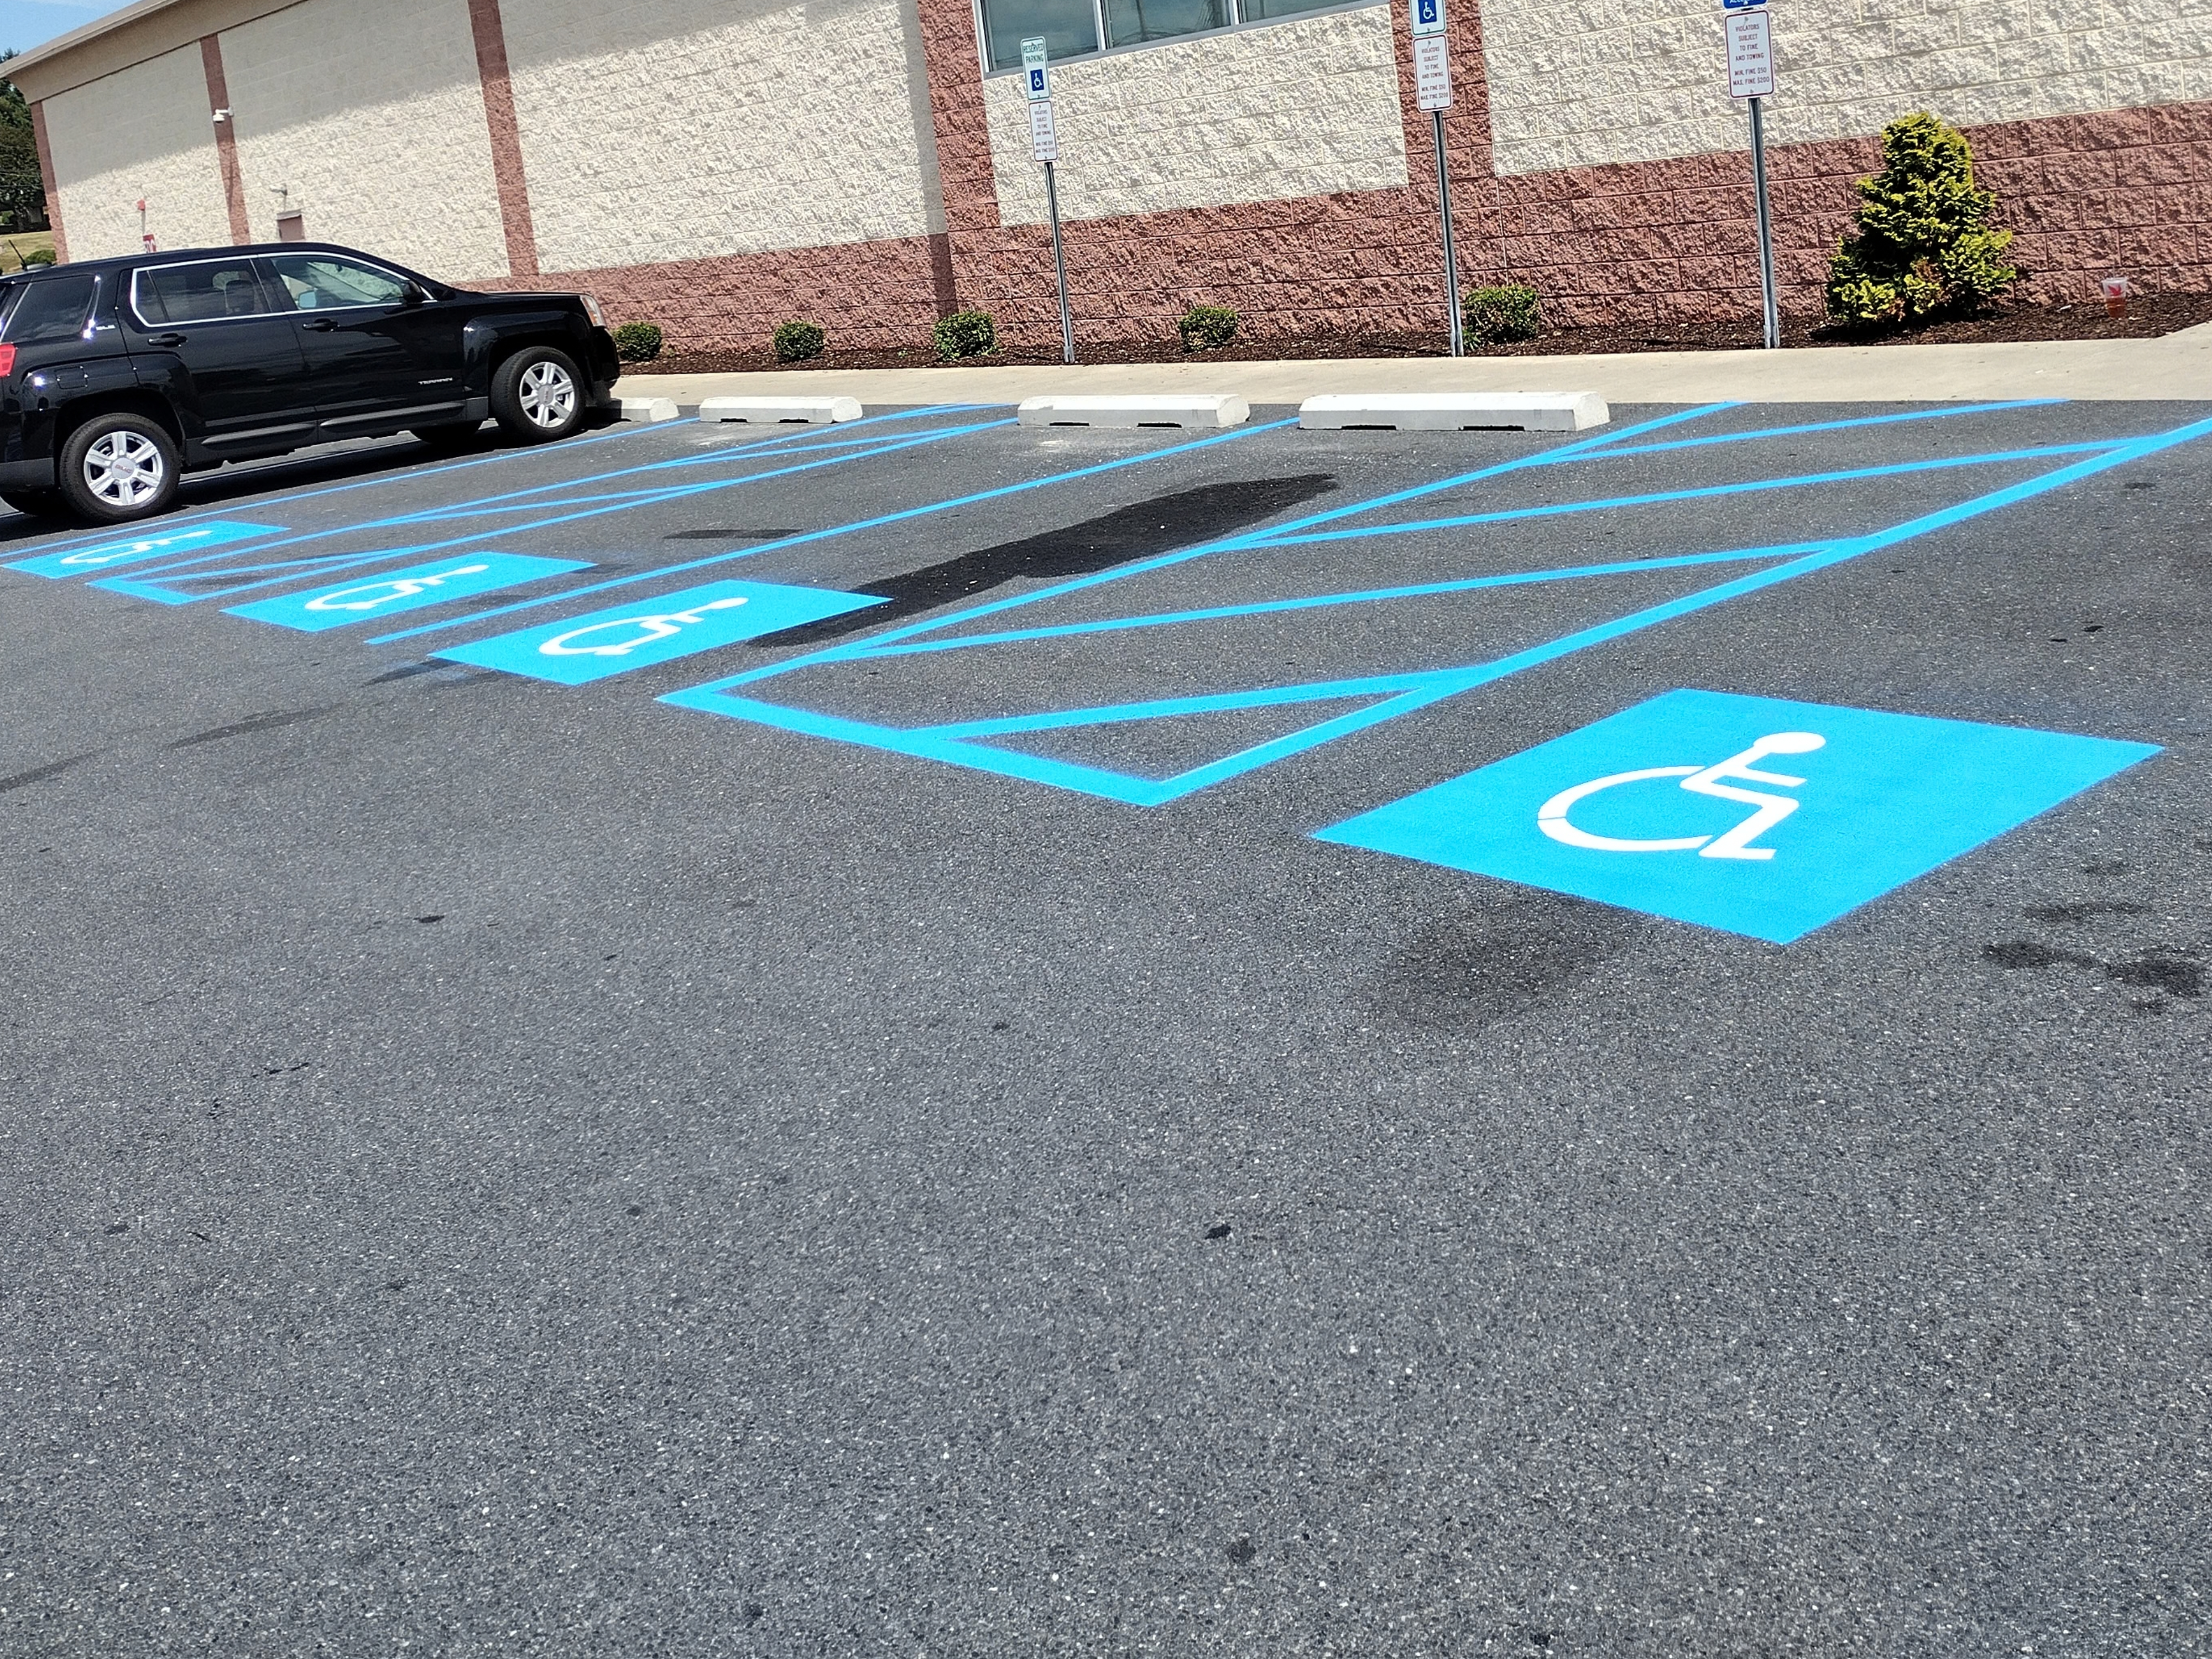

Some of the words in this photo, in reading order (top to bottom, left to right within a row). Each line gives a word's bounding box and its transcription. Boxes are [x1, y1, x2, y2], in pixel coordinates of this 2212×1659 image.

[1735, 24, 1759, 32] VIOLATORS
[1023, 43, 1044, 53] RESERVED
[1026, 54, 1044, 64] PARKING
